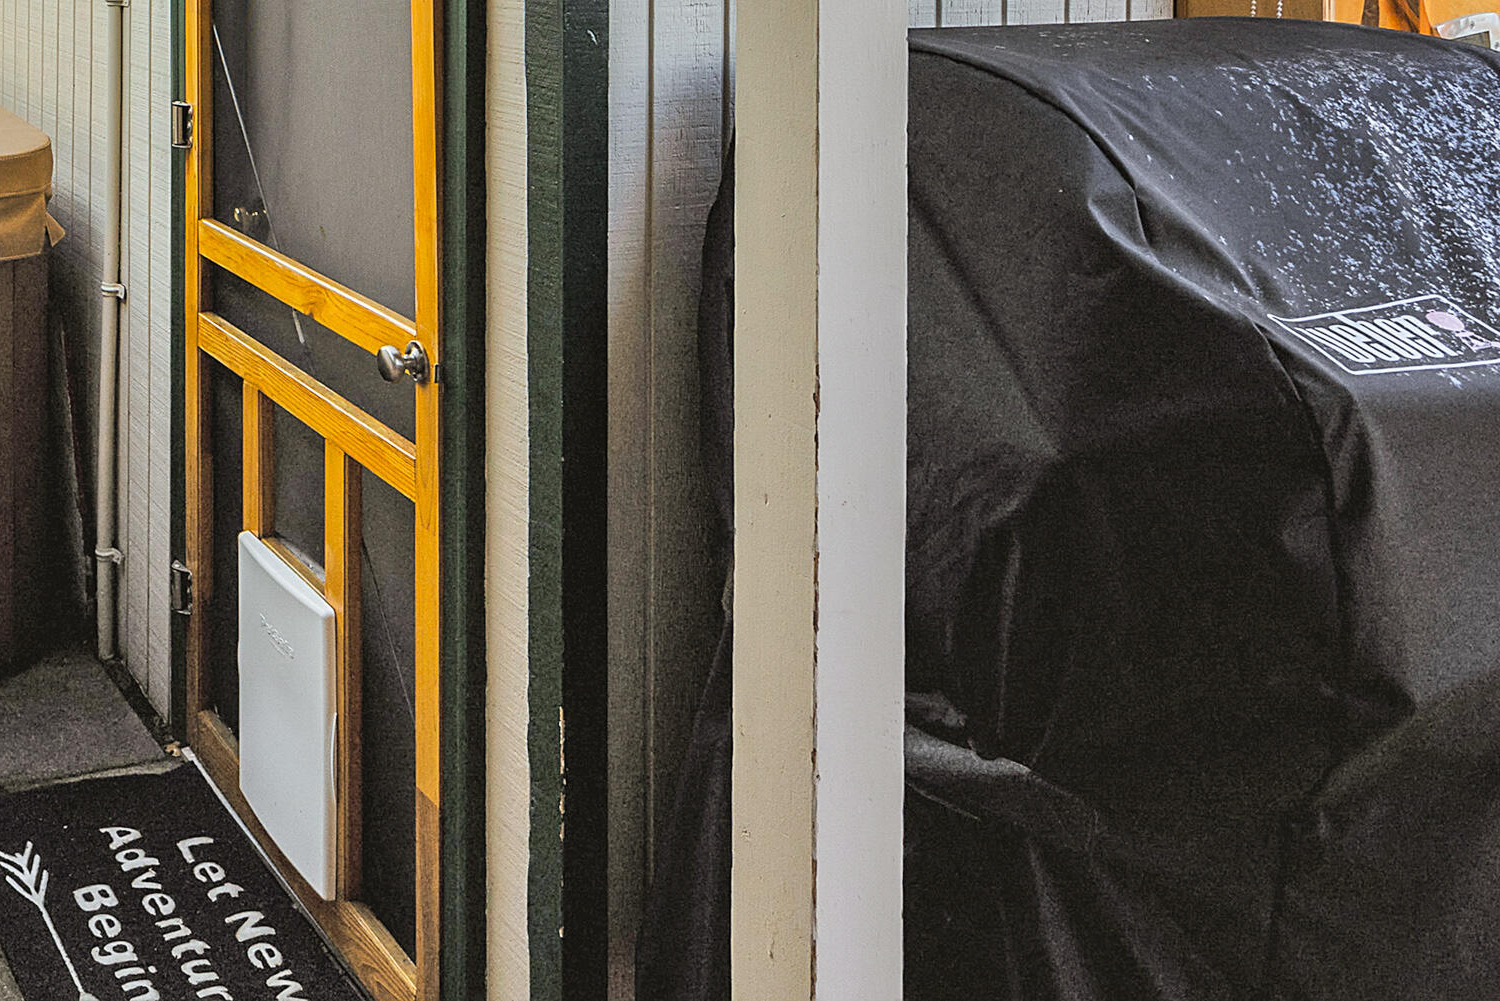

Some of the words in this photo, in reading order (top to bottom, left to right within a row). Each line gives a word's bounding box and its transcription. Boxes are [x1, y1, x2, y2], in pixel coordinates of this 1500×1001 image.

[1292, 313, 1462, 363] weber
[73, 884, 161, 1001] Begin
[99, 826, 234, 1001] Adventur
[176, 836, 245, 903] Let
[224, 910, 309, 1001] New
